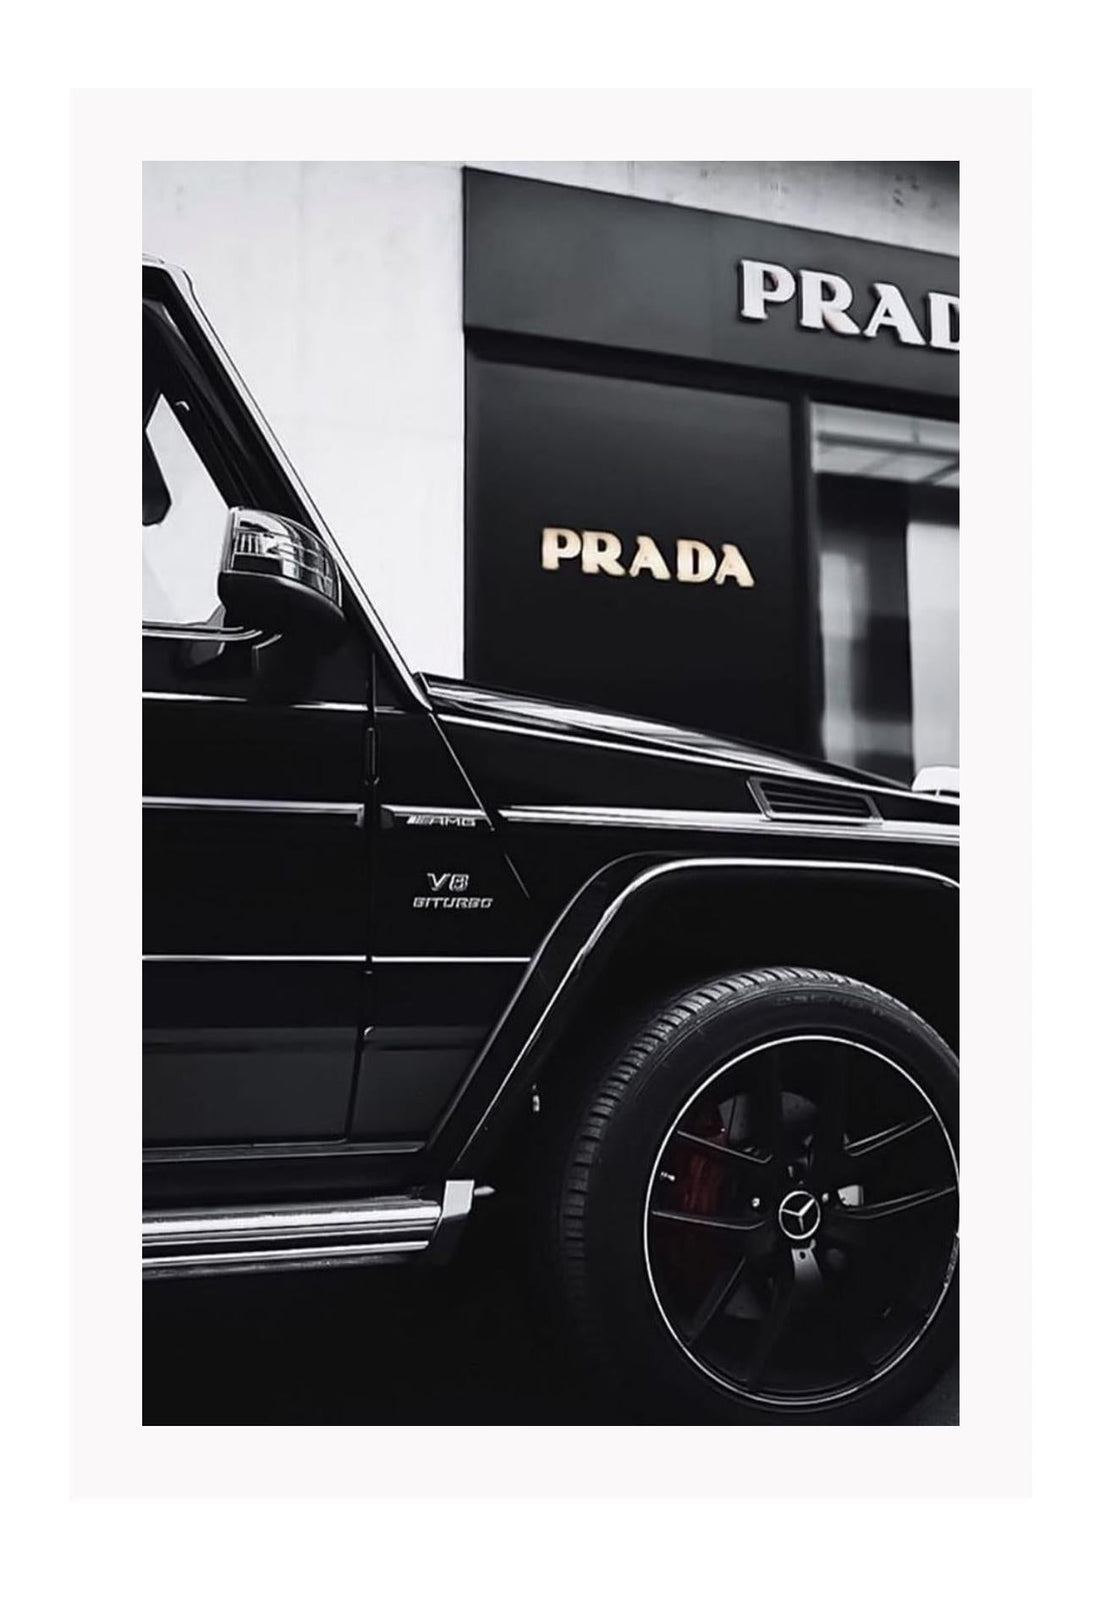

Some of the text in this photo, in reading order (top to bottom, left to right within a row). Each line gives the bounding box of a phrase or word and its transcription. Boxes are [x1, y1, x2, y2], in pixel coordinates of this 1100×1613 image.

[541, 527, 755, 588] PRADA
[426, 873, 469, 892] V8
[412, 897, 494, 909] BITURBO
